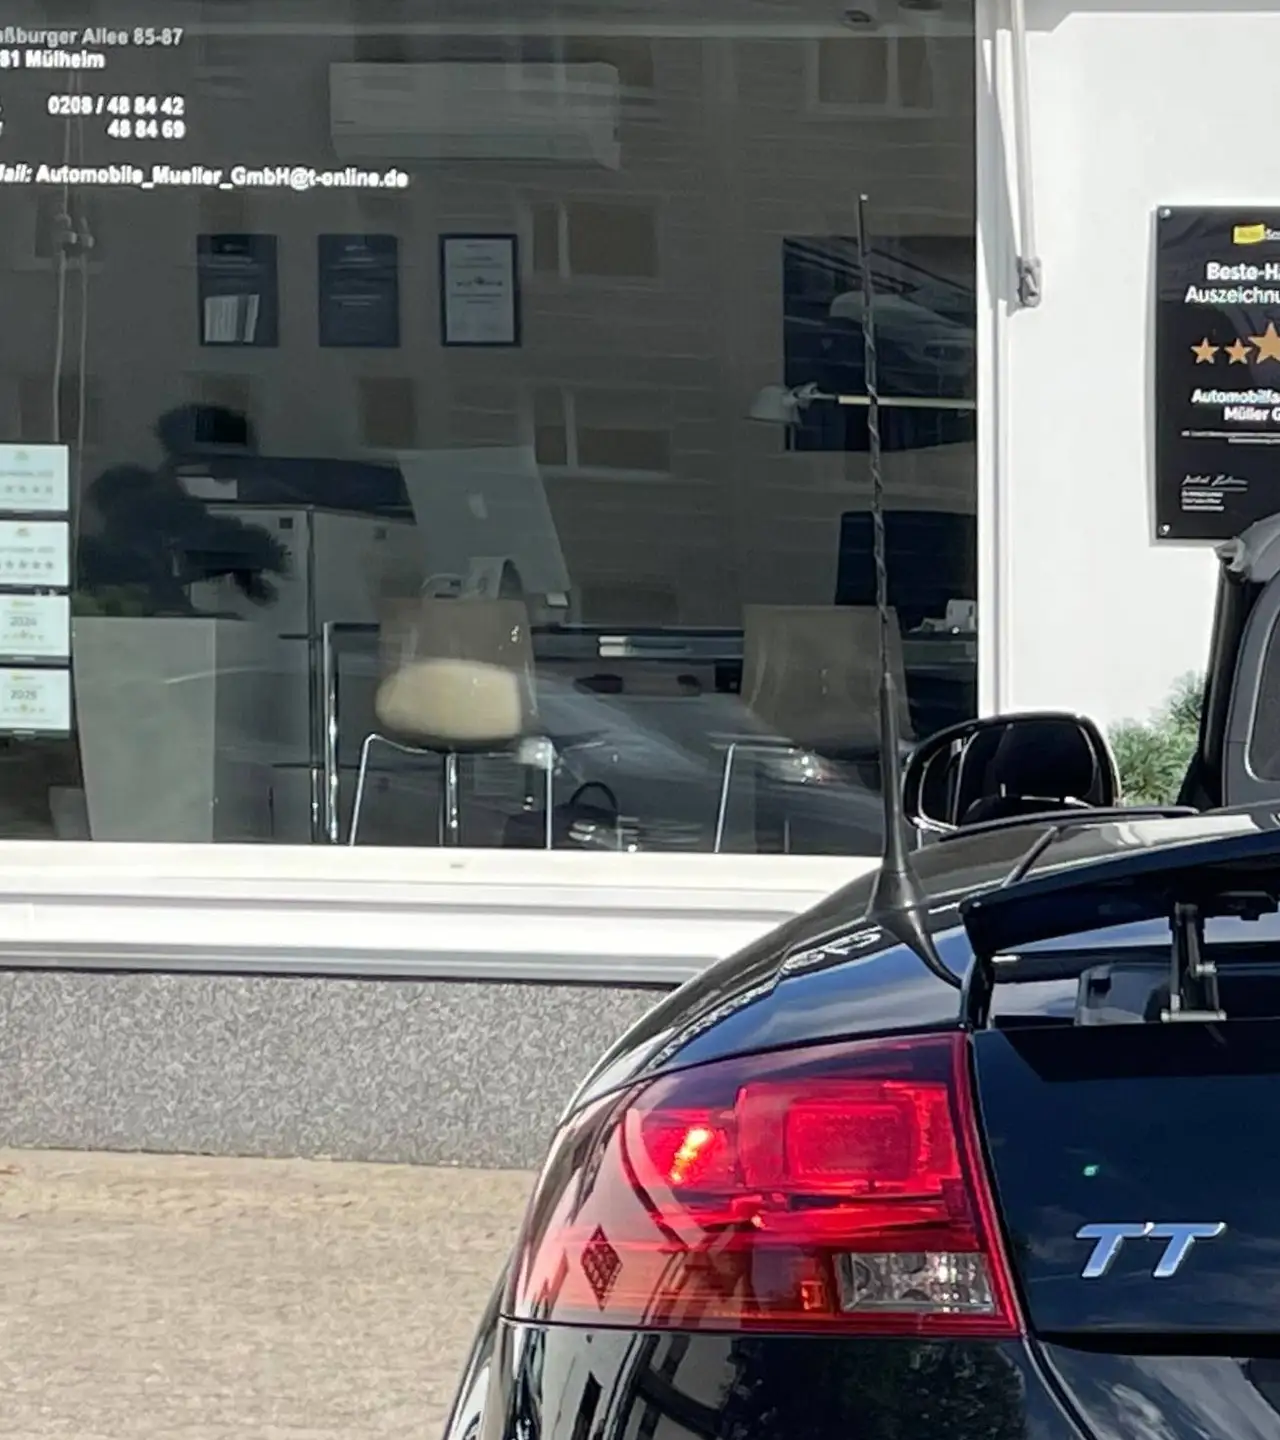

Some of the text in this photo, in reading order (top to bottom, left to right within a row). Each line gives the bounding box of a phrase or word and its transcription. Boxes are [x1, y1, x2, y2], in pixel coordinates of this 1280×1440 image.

[81, 27, 128, 45] Allee
[133, 27, 183, 46] 85-87
[25, 49, 106, 69] Mülheim
[48, 95, 93, 115] 0208
[106, 96, 131, 115] 48
[134, 96, 157, 115] 84
[160, 96, 184, 116] 42
[107, 119, 187, 139] 48 84 69
[1223, 406, 1270, 422] Müller
[1076, 1221, 1227, 1278] TT
